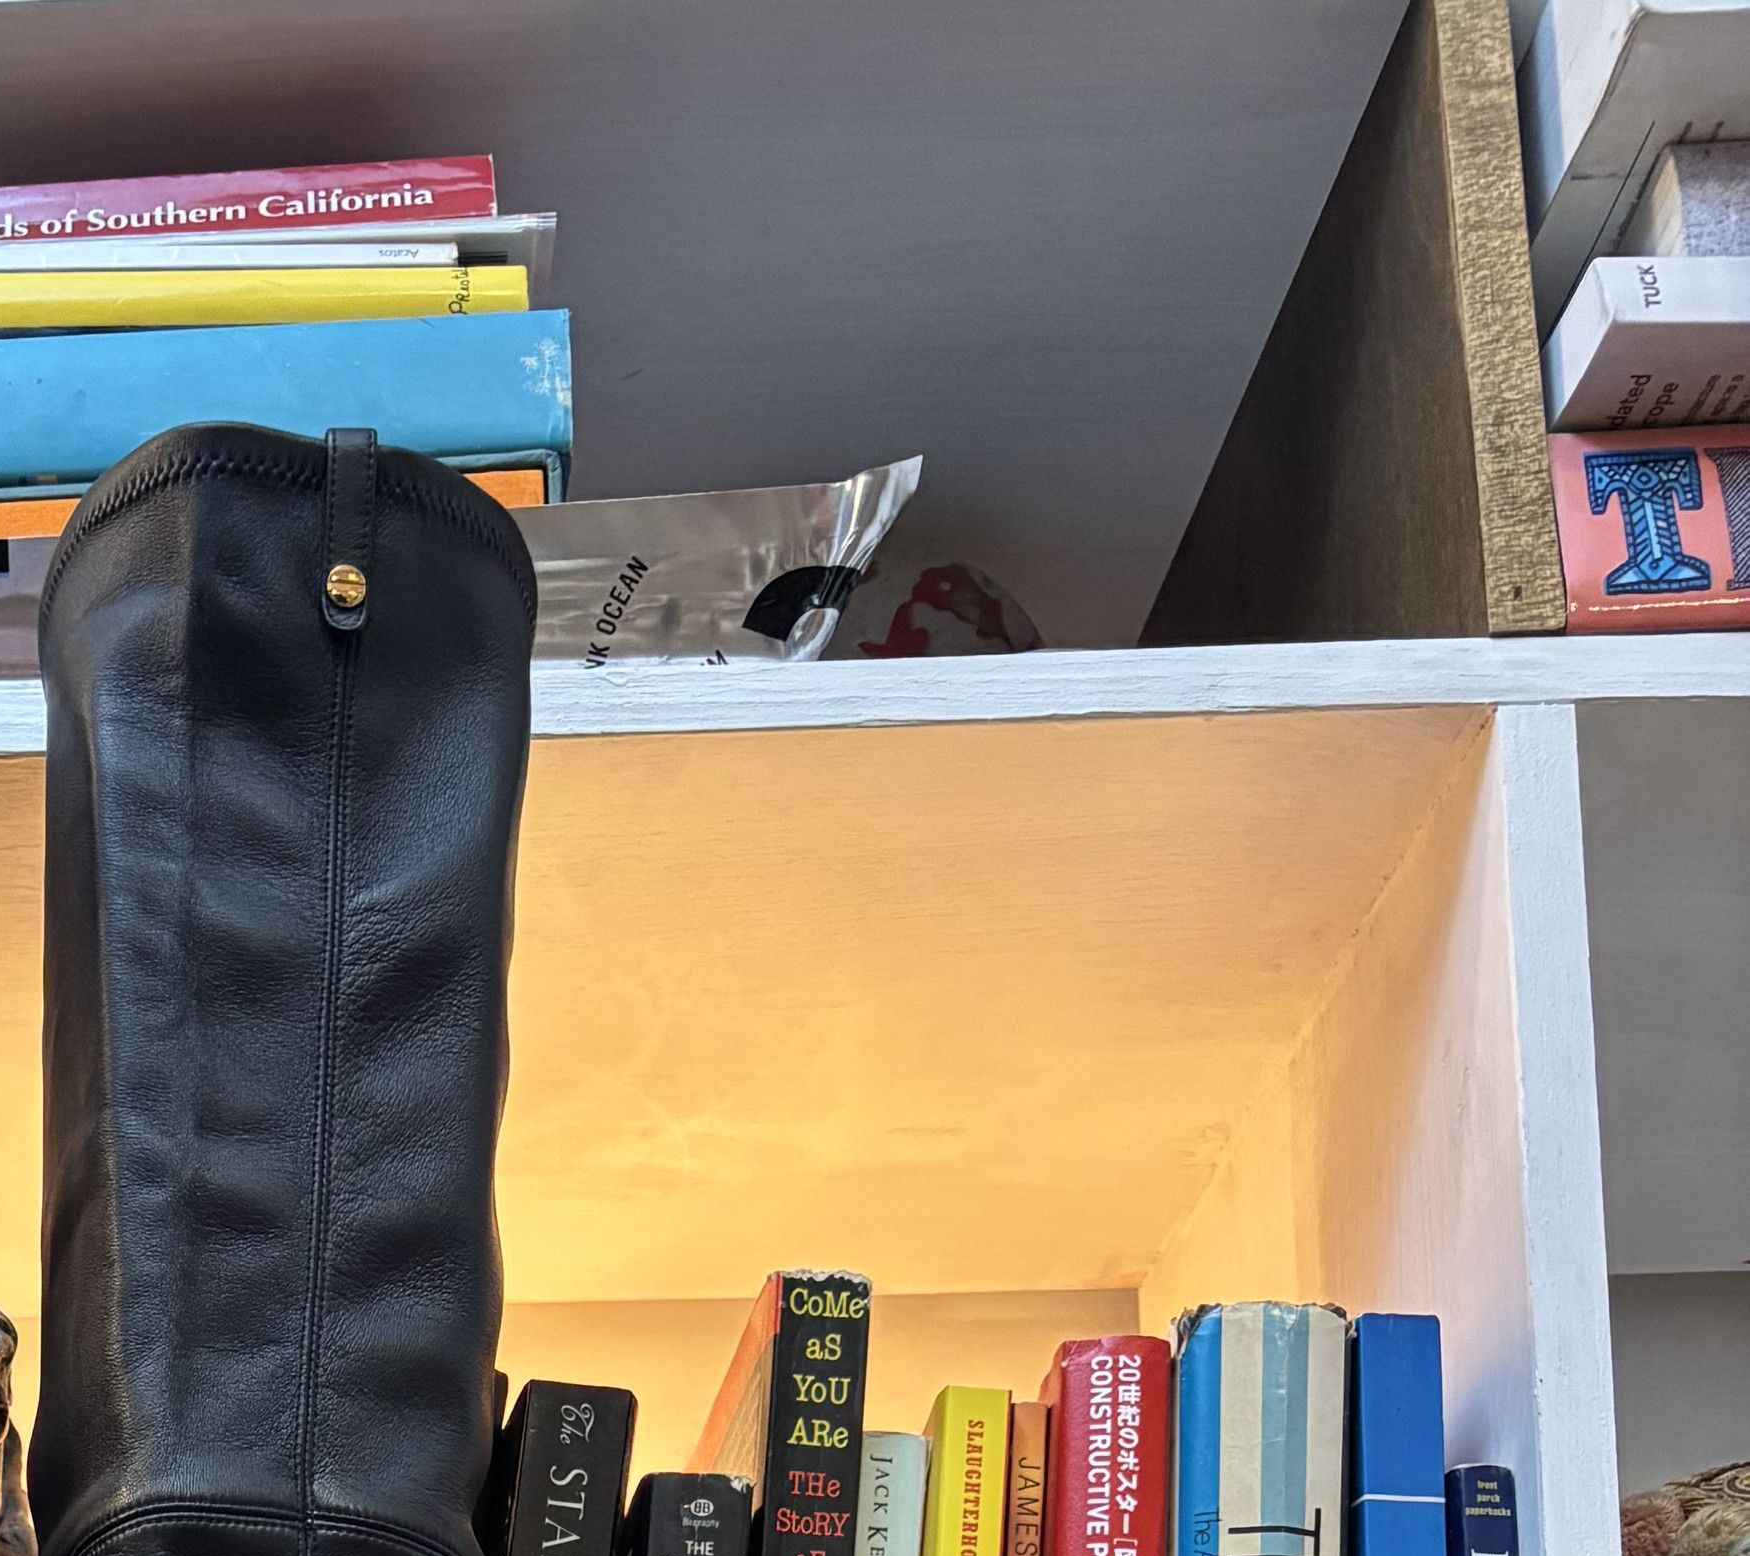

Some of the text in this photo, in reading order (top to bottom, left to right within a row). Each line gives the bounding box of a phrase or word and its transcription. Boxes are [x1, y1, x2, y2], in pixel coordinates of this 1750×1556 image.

[40, 209, 77, 236] of
[87, 200, 247, 231] Southern
[258, 183, 435, 219] California
[1637, 265, 1662, 308] TUCK
[597, 555, 649, 636] OCEAN
[560, 1401, 596, 1445] The
[1086, 1355, 1114, 1537] CONSTRUCTIVE
[869, 1453, 894, 1515] JACK
[1013, 1456, 1042, 1556] JAMES
[685, 1540, 715, 1556] THE
[1193, 1508, 1222, 1546] The
